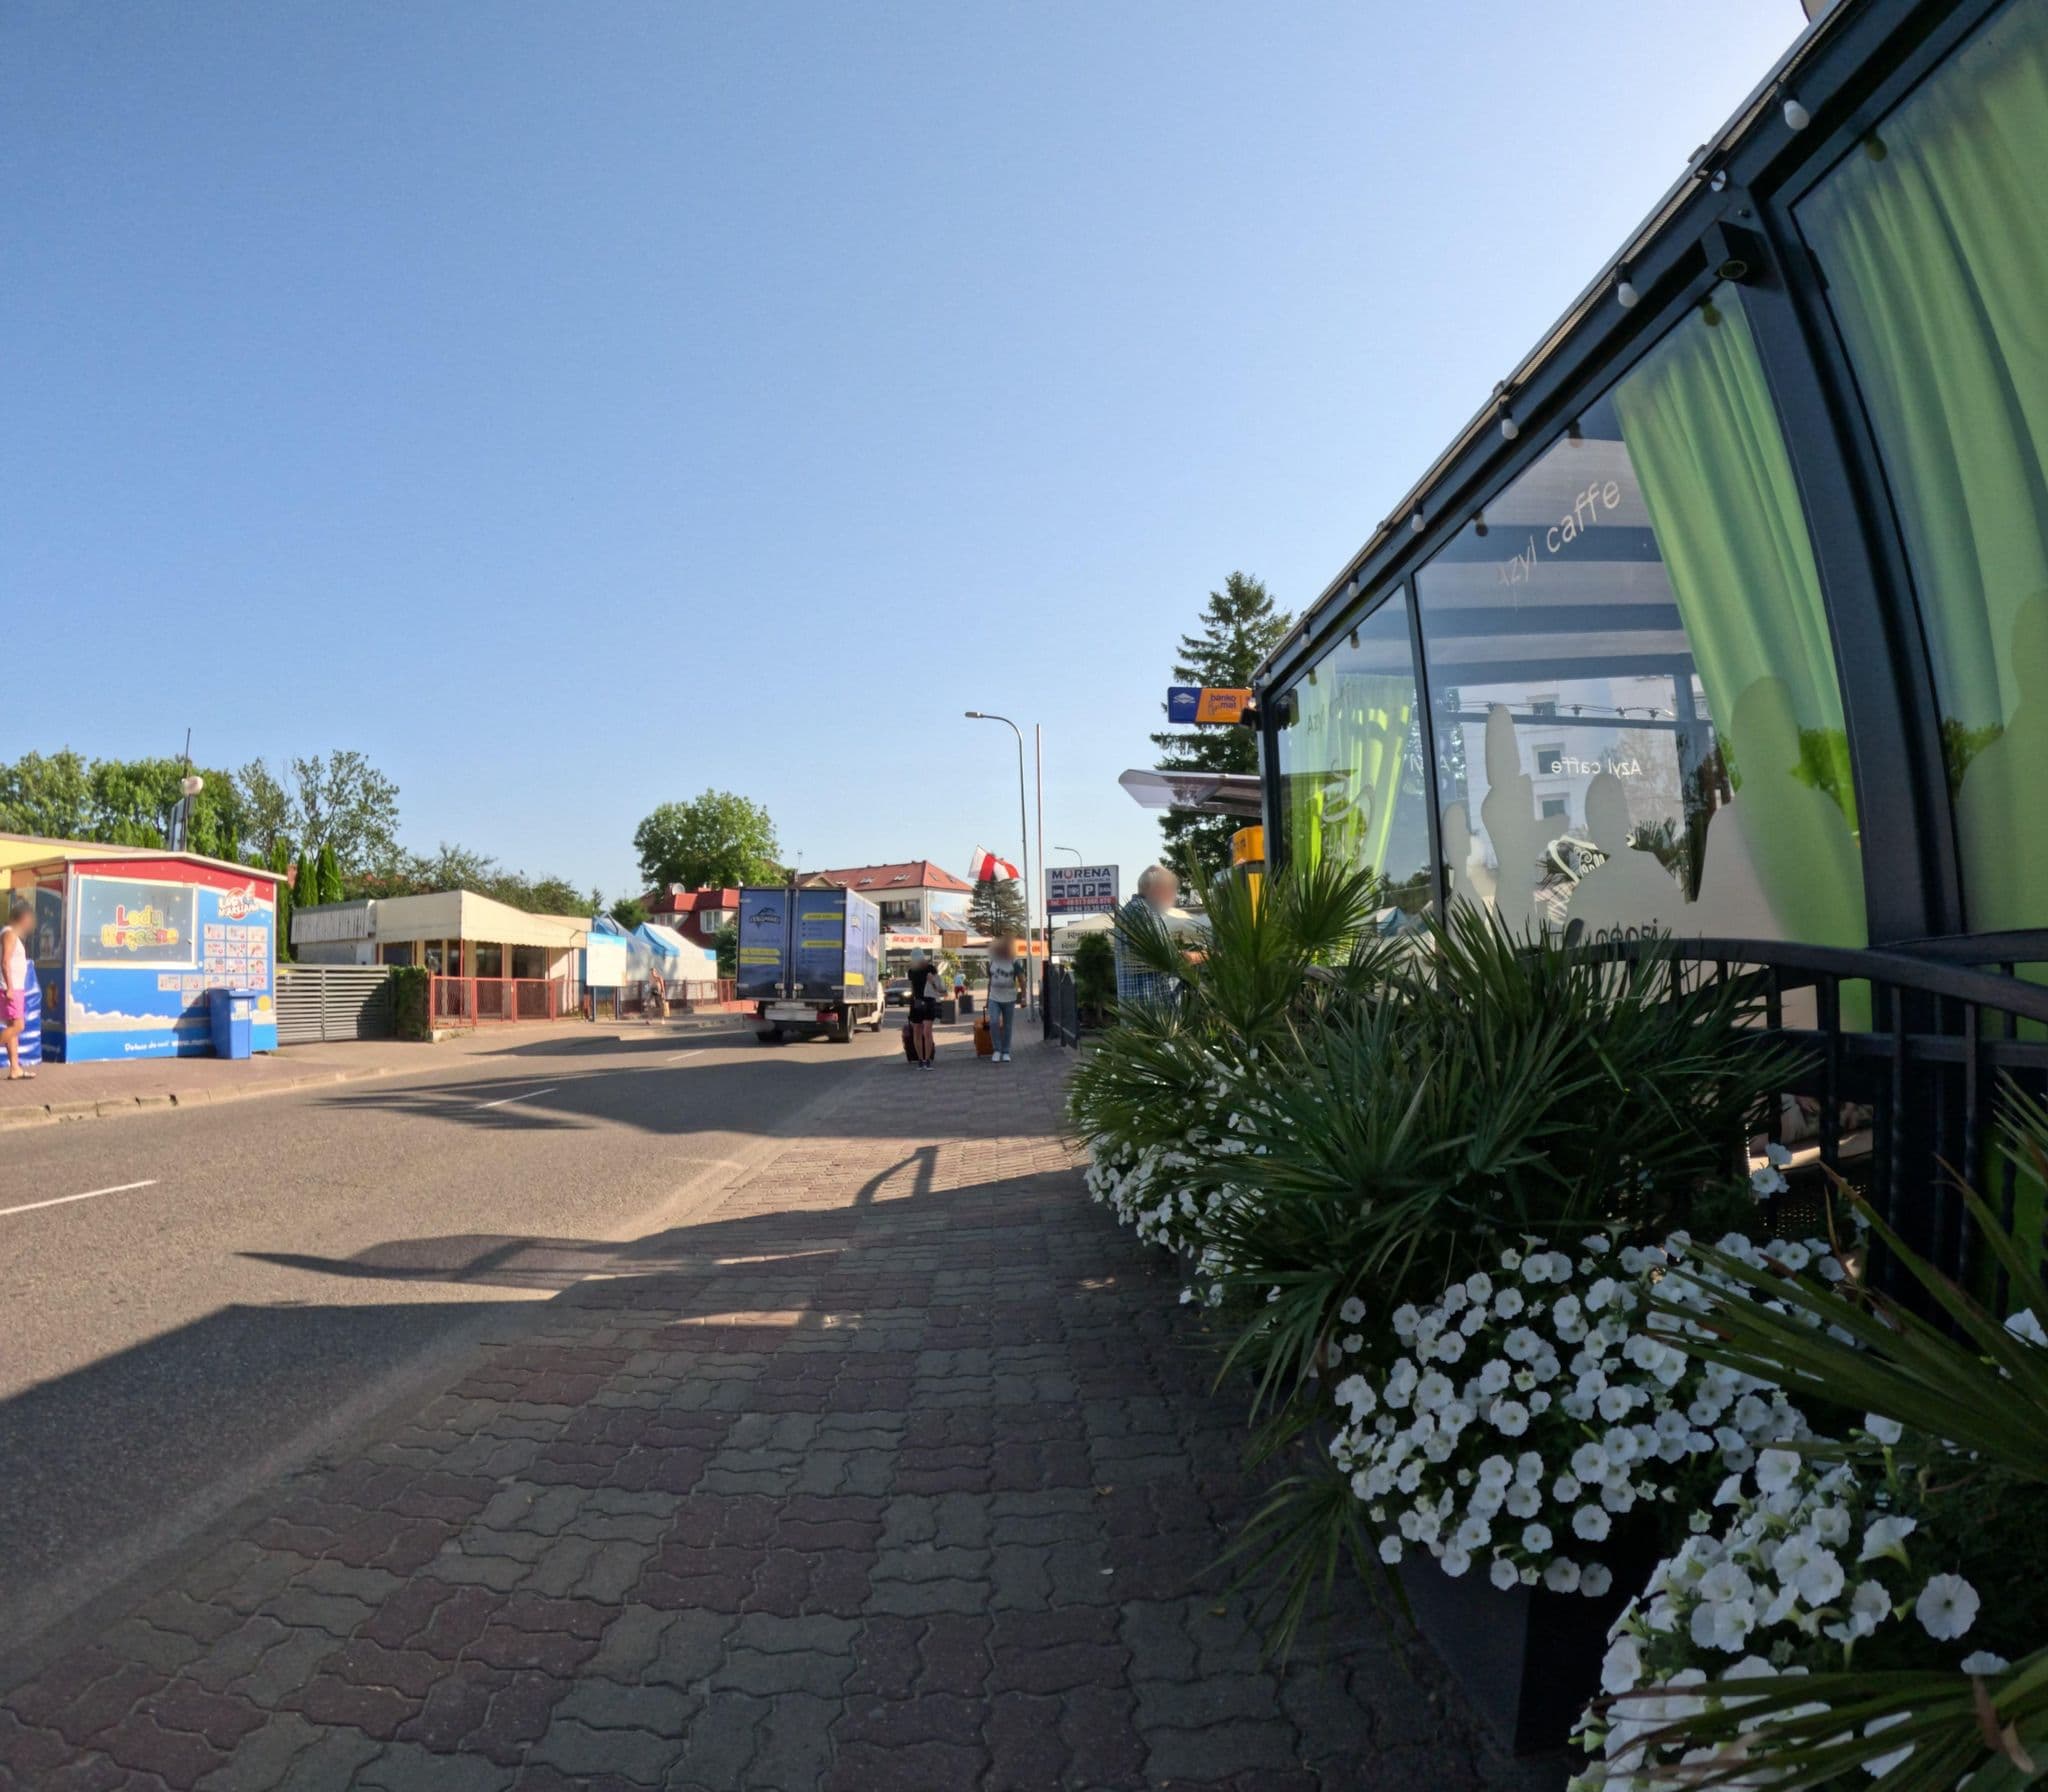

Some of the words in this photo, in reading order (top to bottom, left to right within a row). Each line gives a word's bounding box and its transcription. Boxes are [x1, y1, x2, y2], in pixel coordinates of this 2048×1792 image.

[1546, 480, 1620, 553] caffe
[1085, 885, 1094, 895] P
[117, 905, 163, 927] Lody
